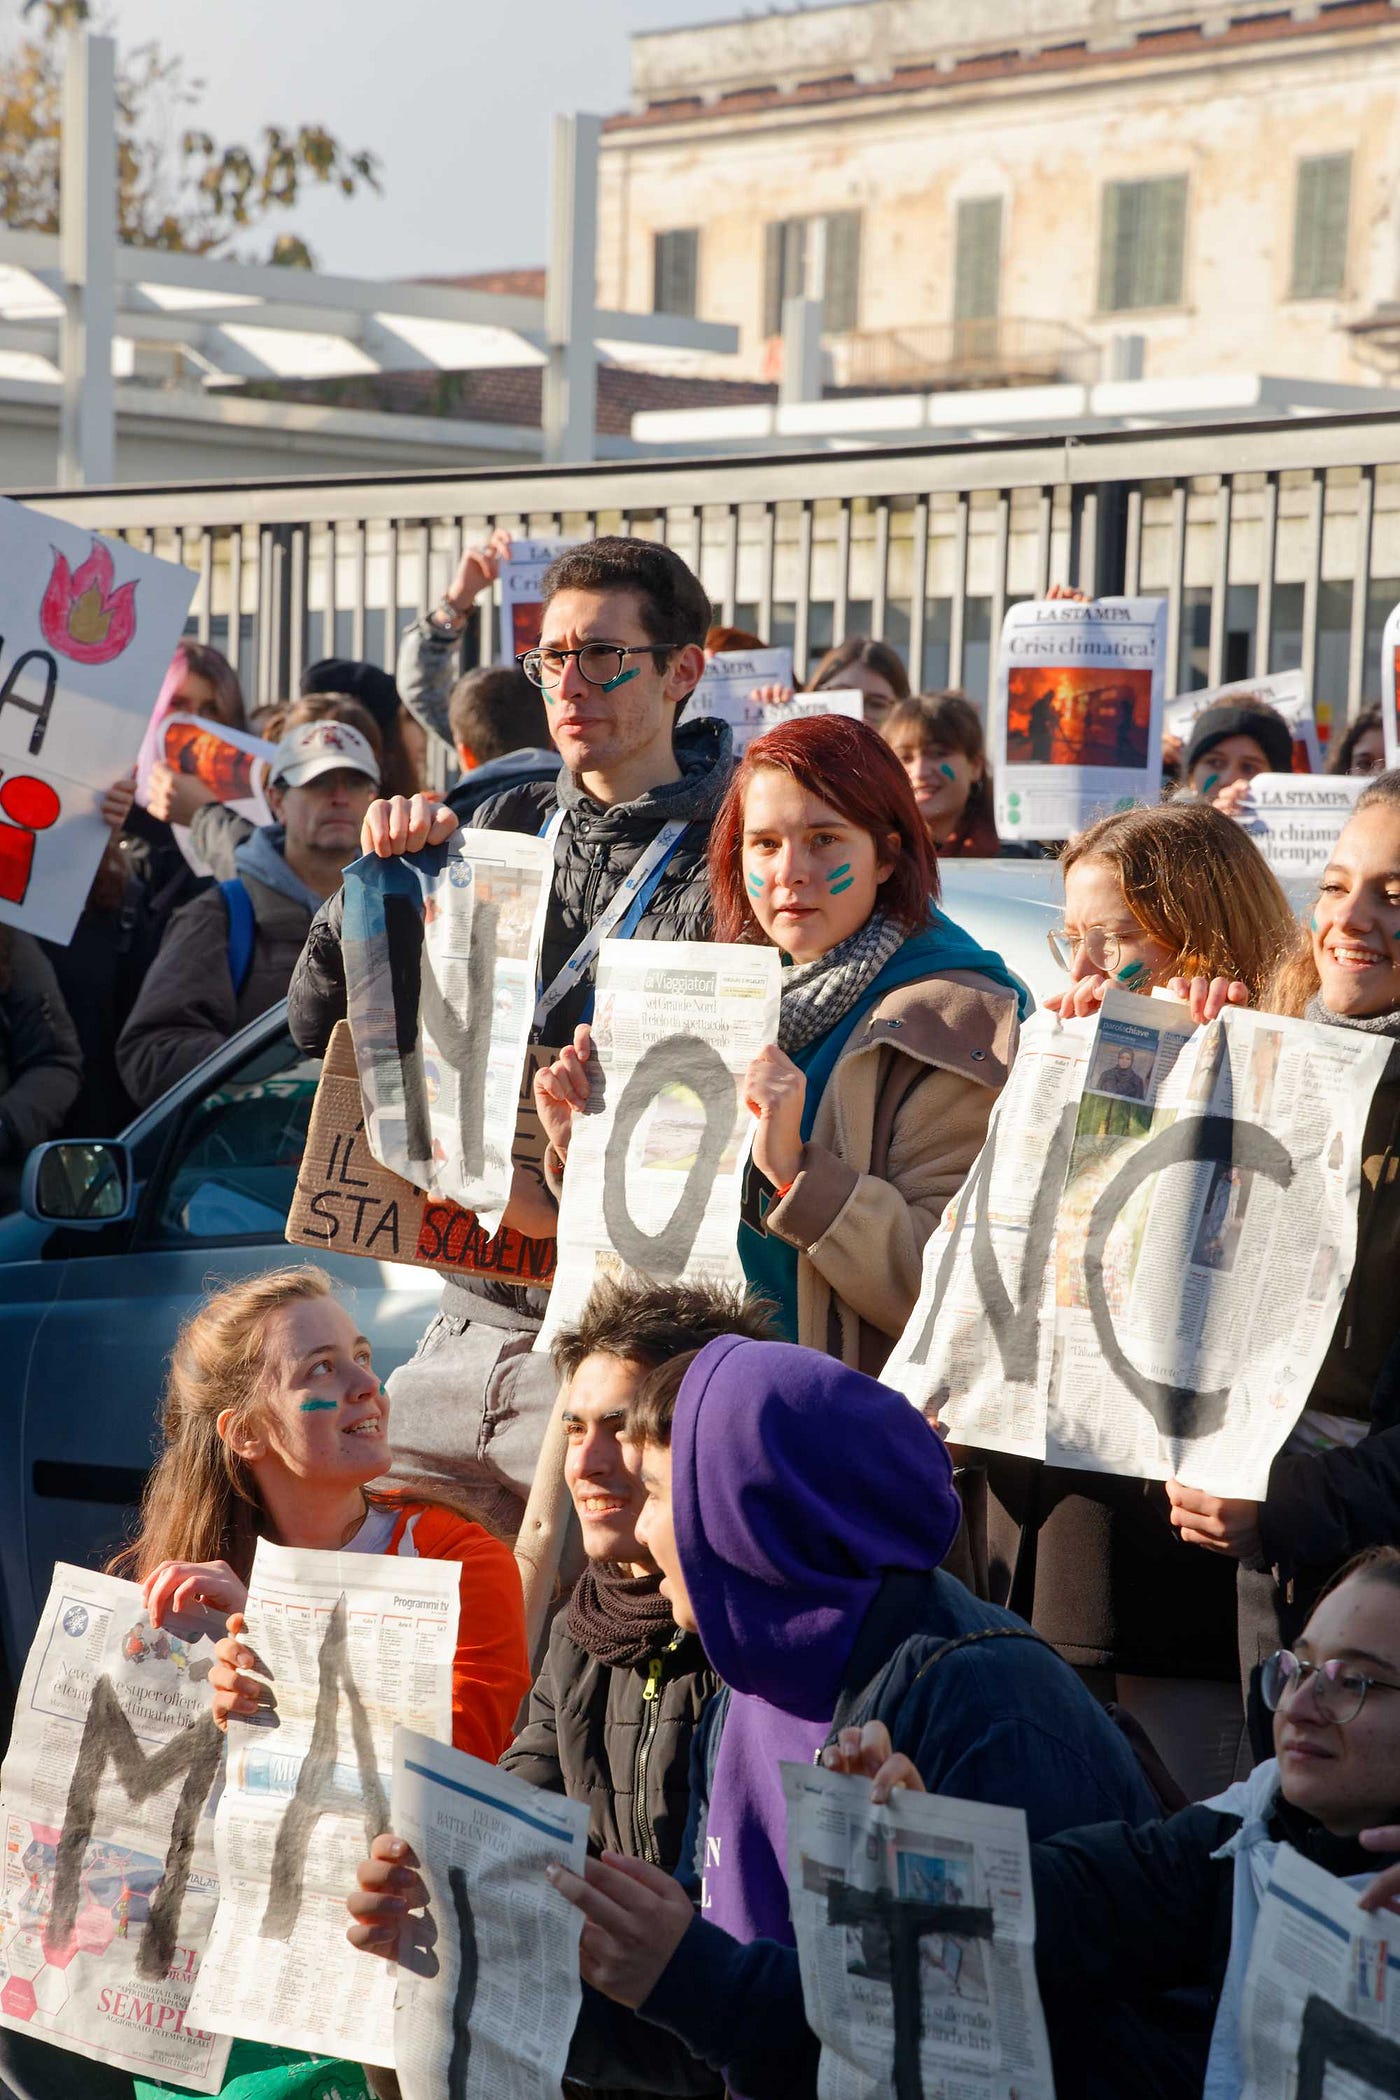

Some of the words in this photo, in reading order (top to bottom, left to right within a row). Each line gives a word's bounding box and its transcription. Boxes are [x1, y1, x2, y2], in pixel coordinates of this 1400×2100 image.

[509, 575, 539, 591] Cri
[1035, 610, 1057, 622] LA
[1060, 608, 1132, 621] STAMPA
[1010, 636, 1057, 655] Crisi
[1059, 637, 1156, 658] climatica!
[1261, 791, 1283, 806] LA
[1285, 790, 1350, 806] STAMPA
[656, 972, 715, 995] Viaggiatori
[326, 1134, 369, 1188] IL
[303, 1190, 399, 1254] STA
[419, 1205, 558, 1279] SCADEN
[393, 1595, 439, 1611] Programmi
[440, 1600, 450, 1612] tv
[62, 1661, 90, 1683] Neve,
[125, 1684, 162, 1702] super
[163, 1690, 205, 1712] offerte
[62, 1683, 95, 1704] temp
[119, 1700, 175, 1724] ettimana
[706, 1836, 722, 1868] N
[105, 2014, 151, 2033] AGGIORNATO
[161, 2029, 186, 2043] TEMPO
[187, 2036, 211, 2048] REALE
